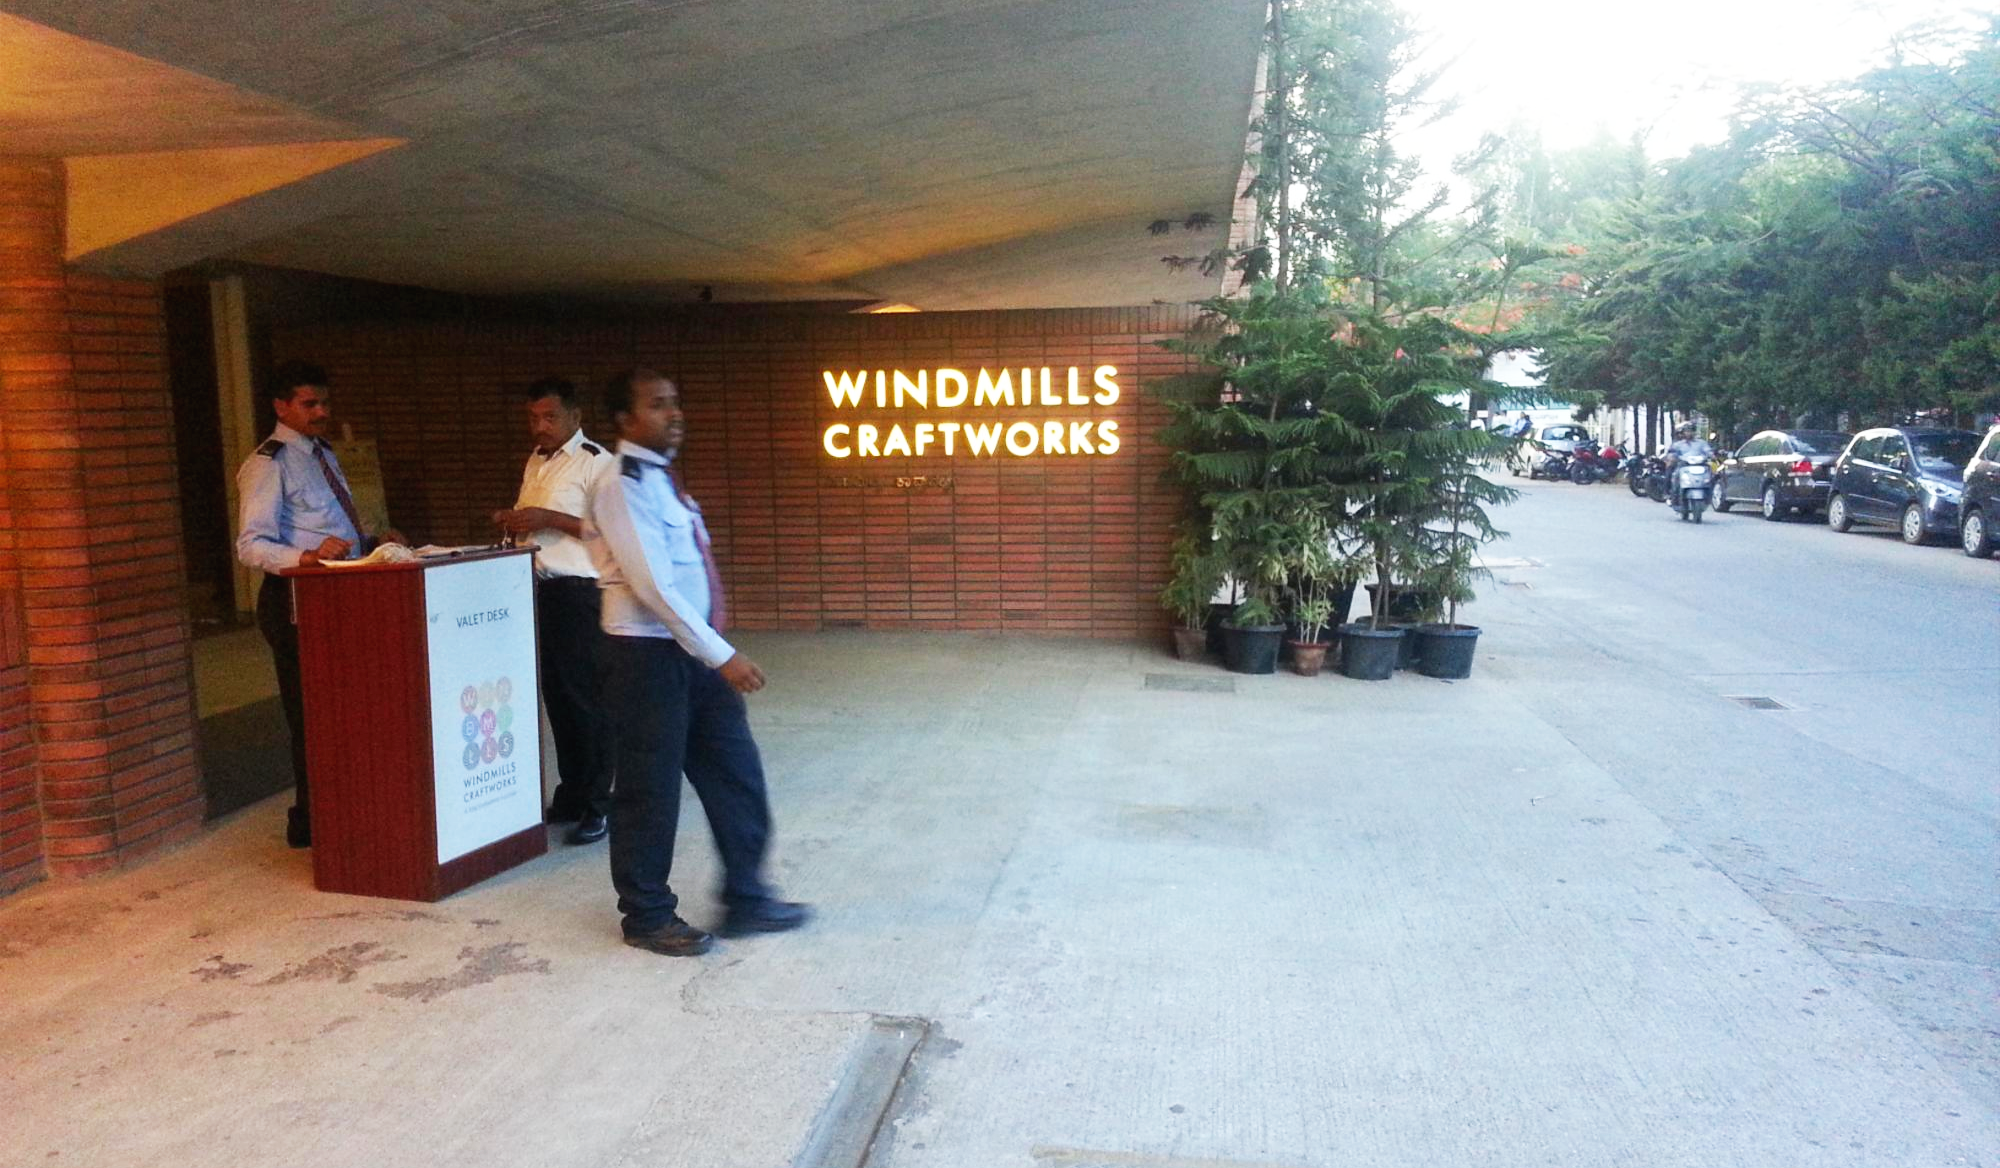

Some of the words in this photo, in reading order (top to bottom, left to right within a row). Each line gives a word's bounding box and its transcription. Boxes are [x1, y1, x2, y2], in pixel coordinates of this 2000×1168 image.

[822, 365, 1121, 409] WINDMILLS
[822, 420, 1121, 458] CRAFTWORKS
[456, 612, 484, 628] VALET
[487, 608, 509, 622] DESK
[463, 761, 516, 788] WINDMILLS
[463, 775, 517, 803] CRAFTWORKS
